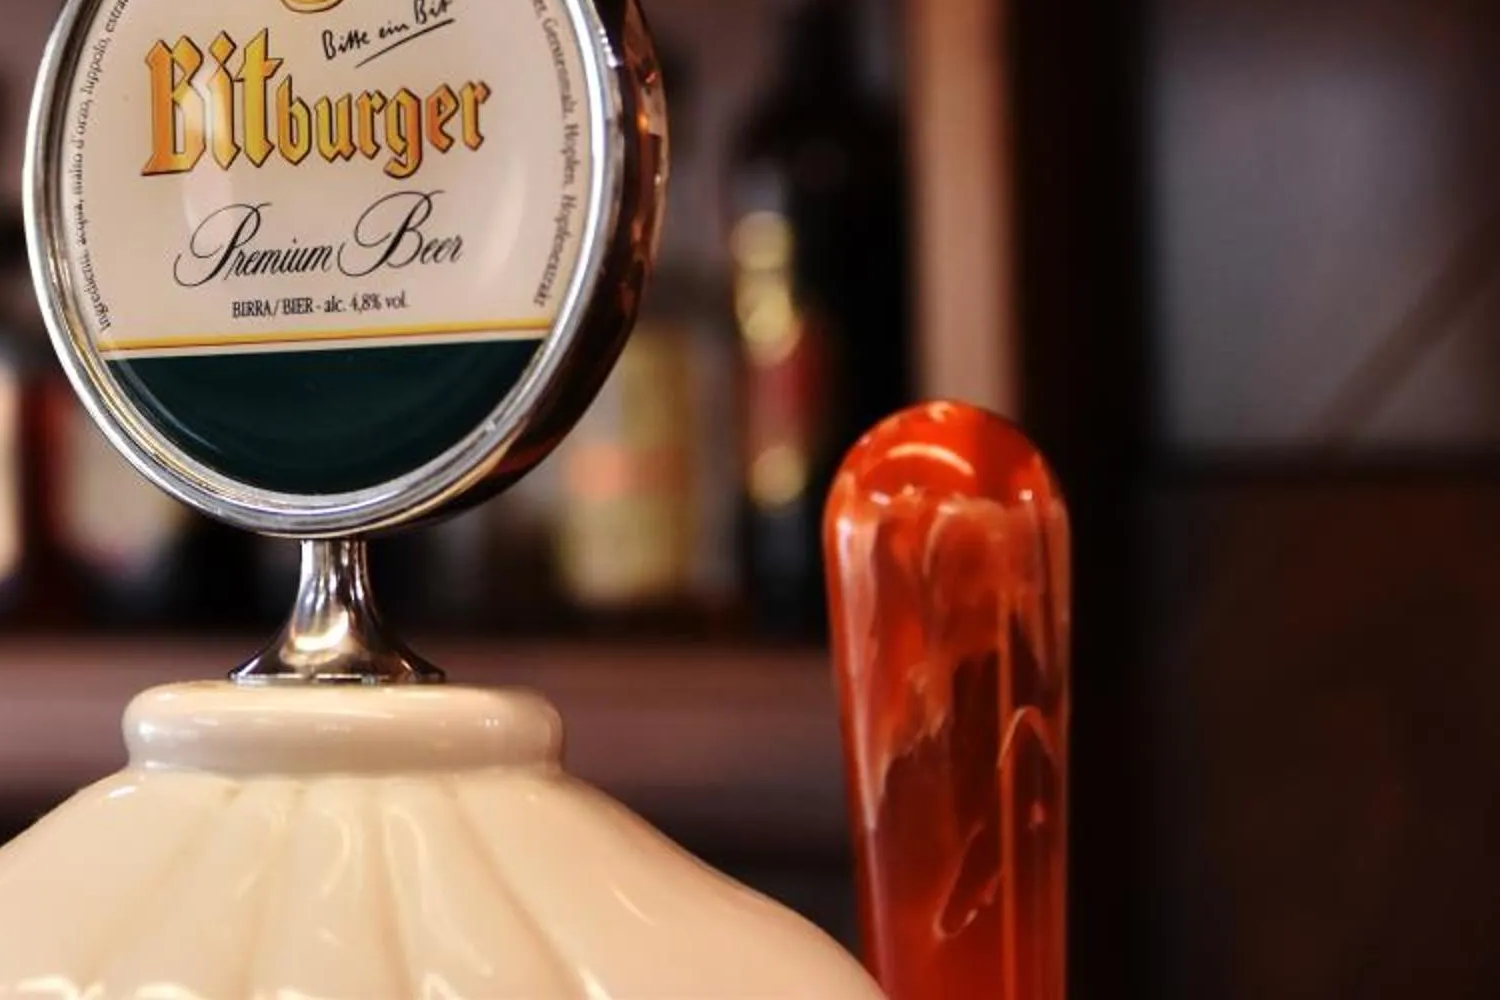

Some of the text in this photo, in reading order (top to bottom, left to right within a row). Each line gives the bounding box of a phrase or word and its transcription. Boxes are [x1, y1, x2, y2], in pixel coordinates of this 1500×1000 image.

[322, 29, 371, 61] Bitte
[378, 20, 410, 39] ein
[140, 26, 492, 179] Bitburger
[173, 189, 464, 288] Premium Beer
[350, 292, 382, 315] 4,8%
